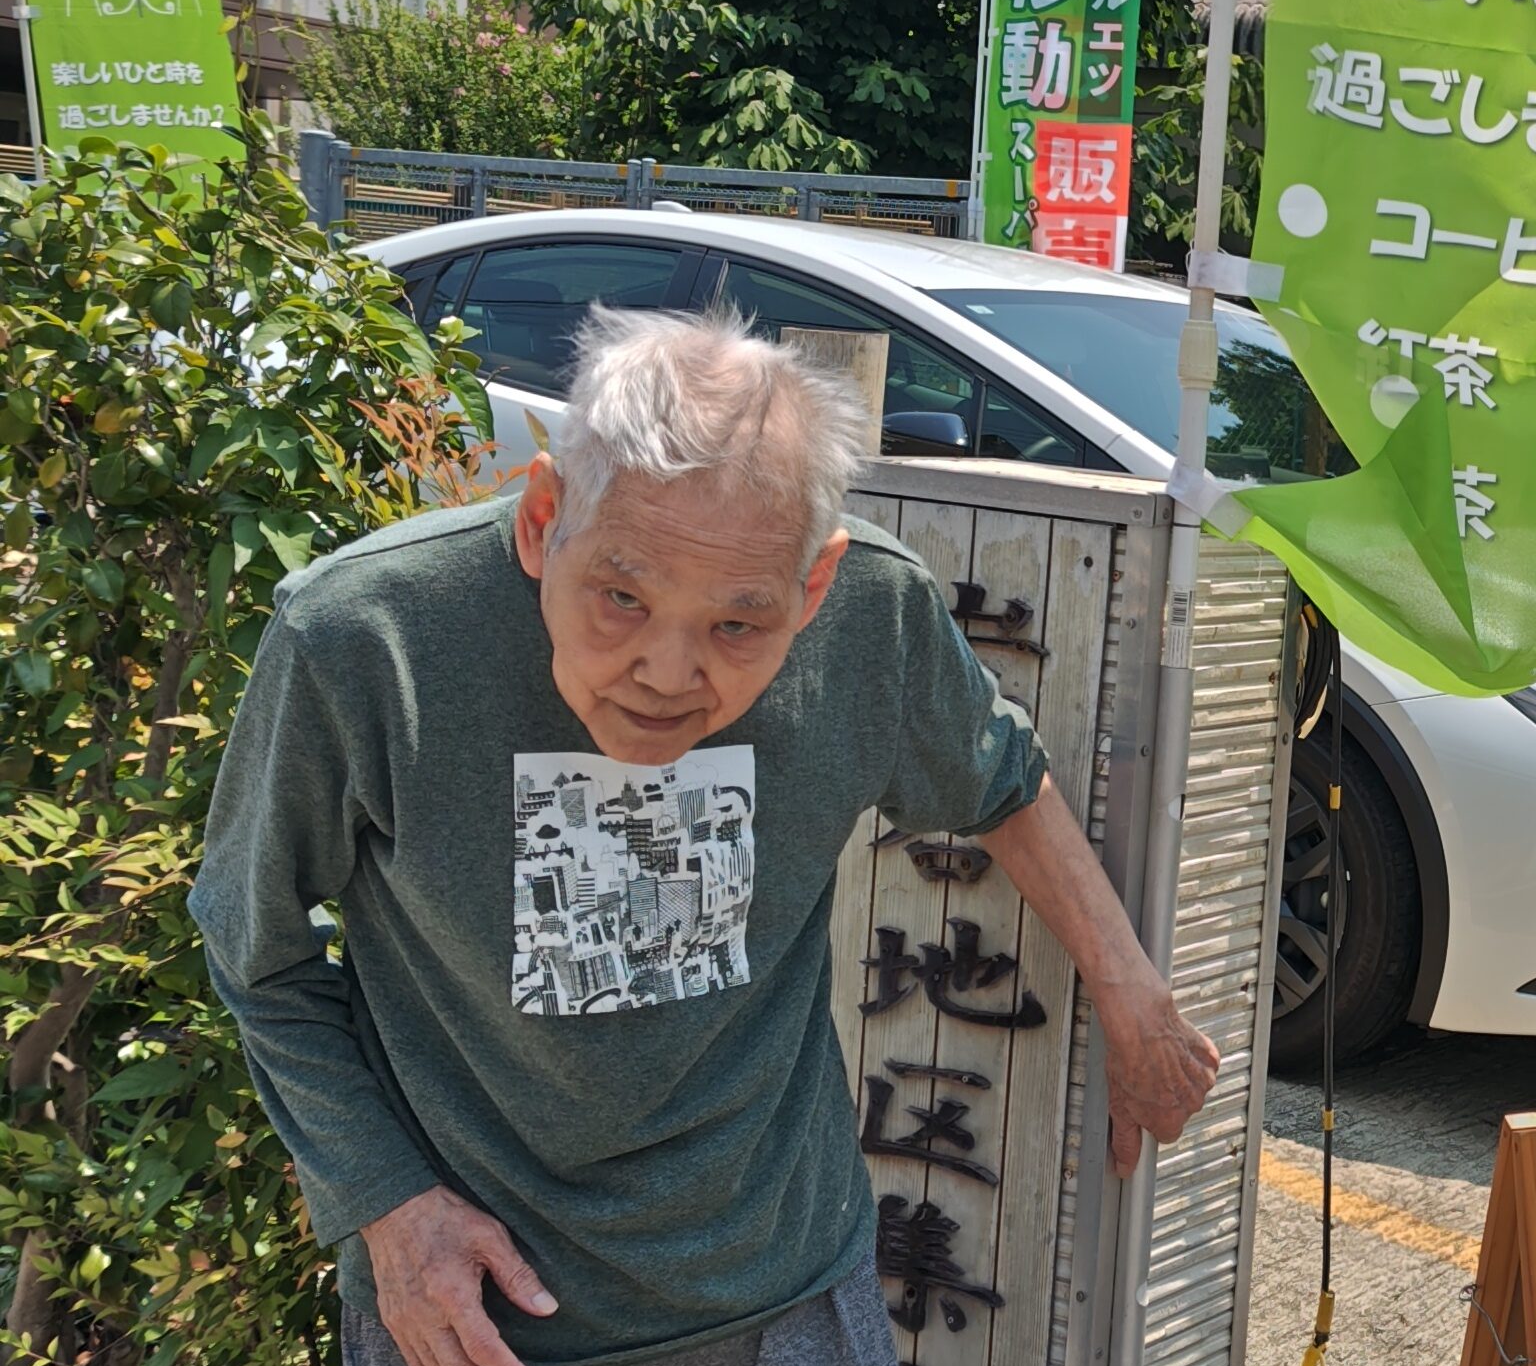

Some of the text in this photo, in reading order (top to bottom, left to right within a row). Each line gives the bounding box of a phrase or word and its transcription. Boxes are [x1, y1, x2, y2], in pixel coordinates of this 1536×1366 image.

[51, 61, 204, 85] 楽しいひと時を
[1003, 122, 1038, 250] スーパ
